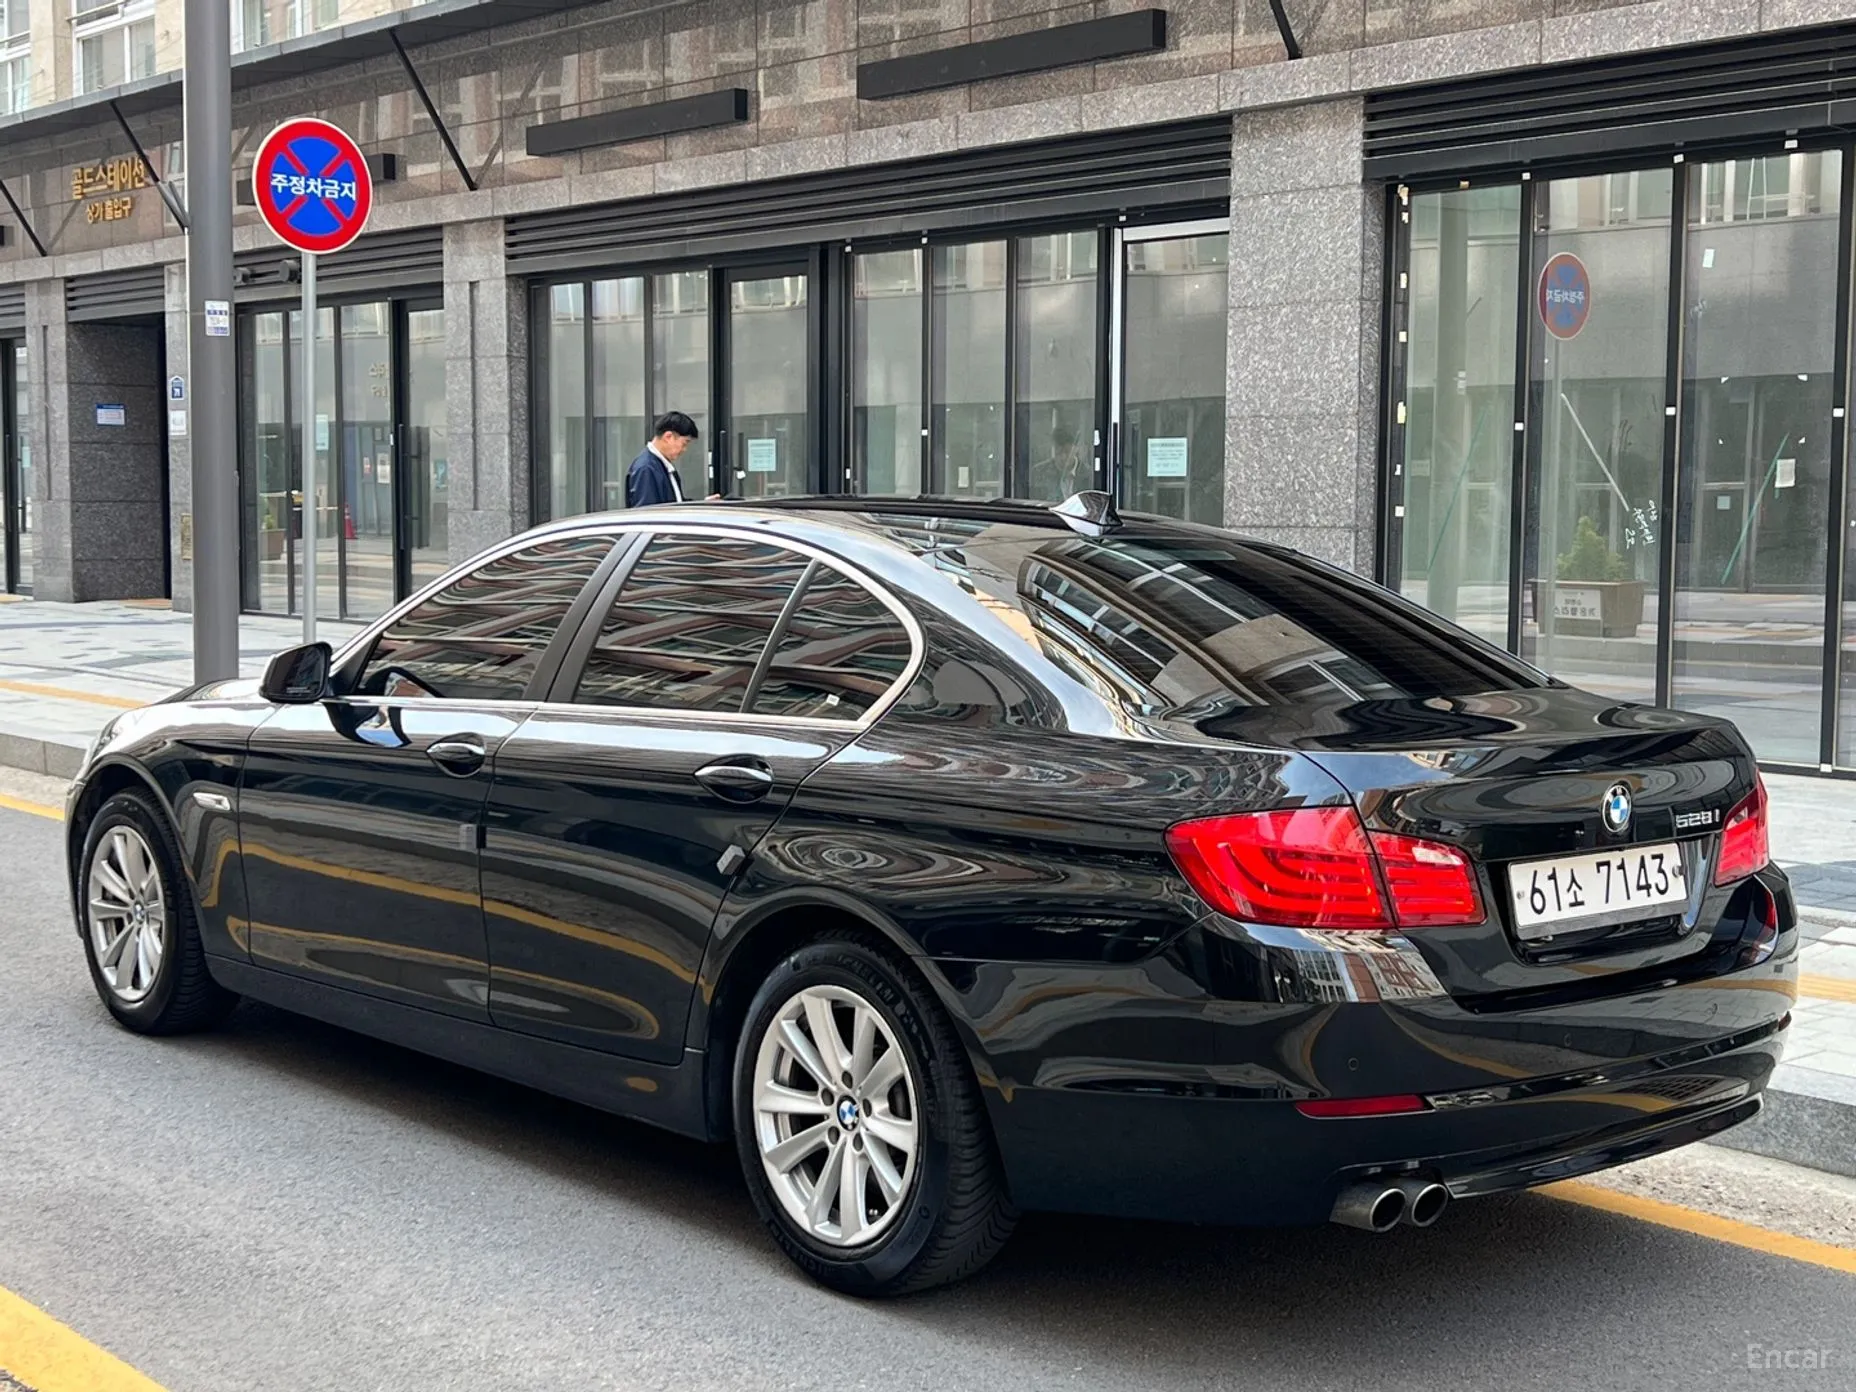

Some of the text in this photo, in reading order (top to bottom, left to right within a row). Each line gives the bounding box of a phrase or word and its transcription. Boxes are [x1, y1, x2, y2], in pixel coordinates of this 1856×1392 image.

[71, 156, 145, 200] 골드스테이션
[270, 173, 357, 201] 주정차금지
[1530, 852, 1669, 915] 61소 7143
